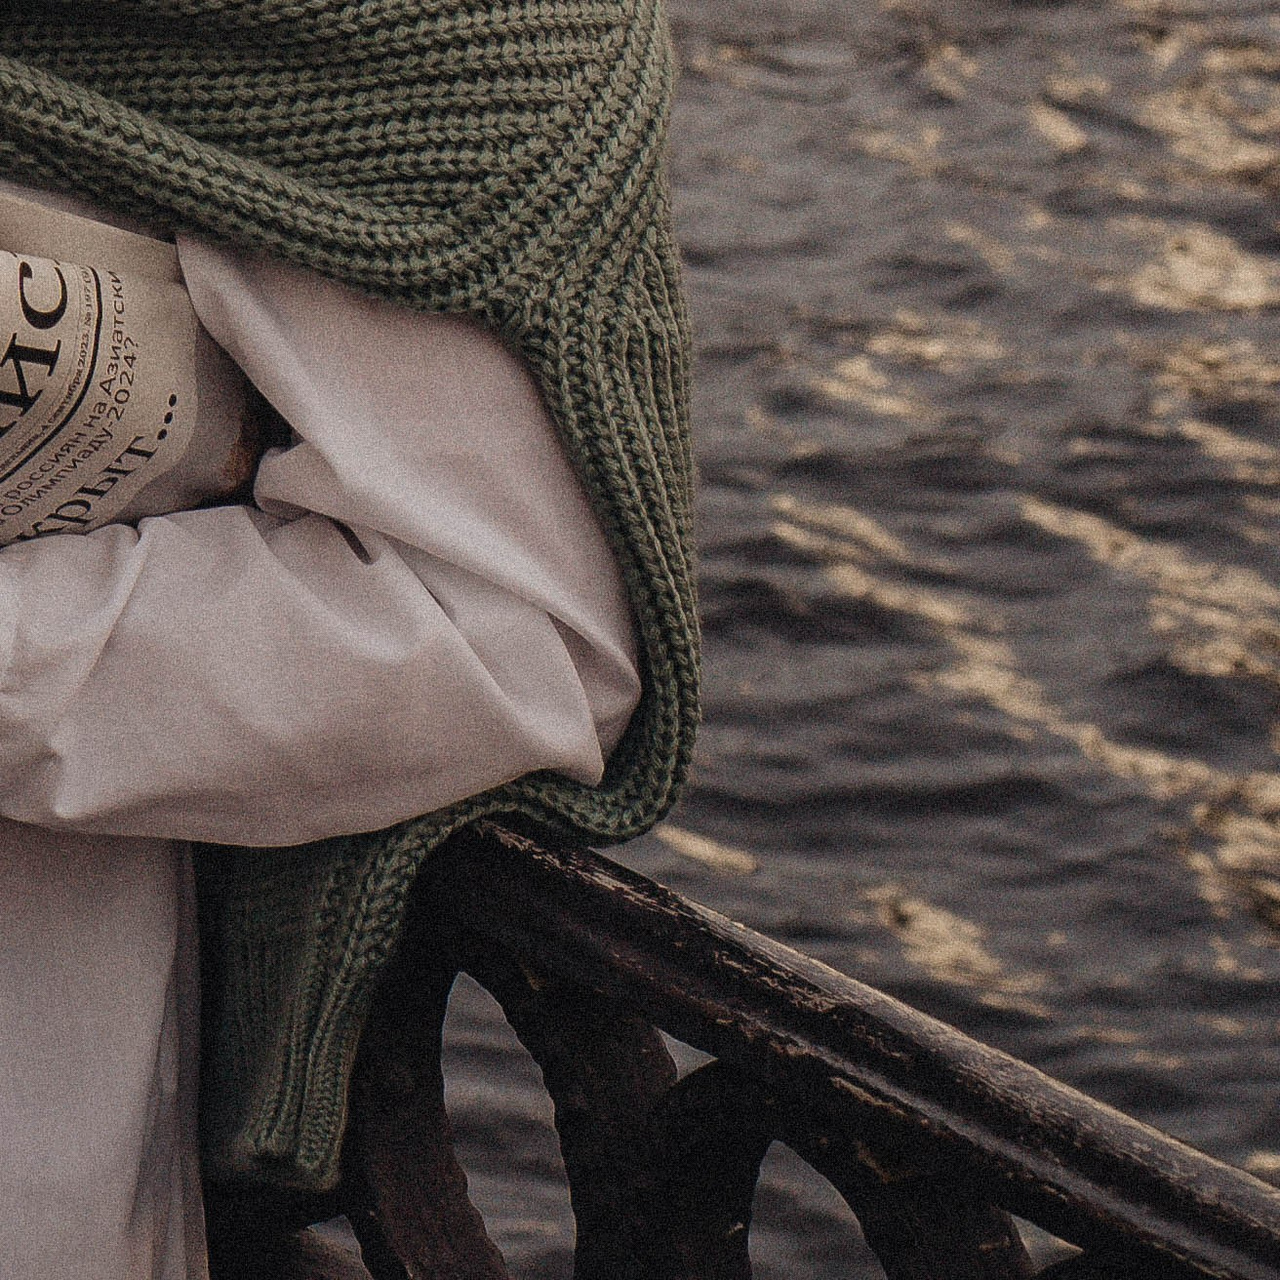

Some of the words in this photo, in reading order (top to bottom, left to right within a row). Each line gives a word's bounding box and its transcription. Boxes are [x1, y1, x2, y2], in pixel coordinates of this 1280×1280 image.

[1, 336, 139, 515] Олимпиаду-2024?
[5, 431, 87, 504] россиян
[83, 401, 108, 428] на
